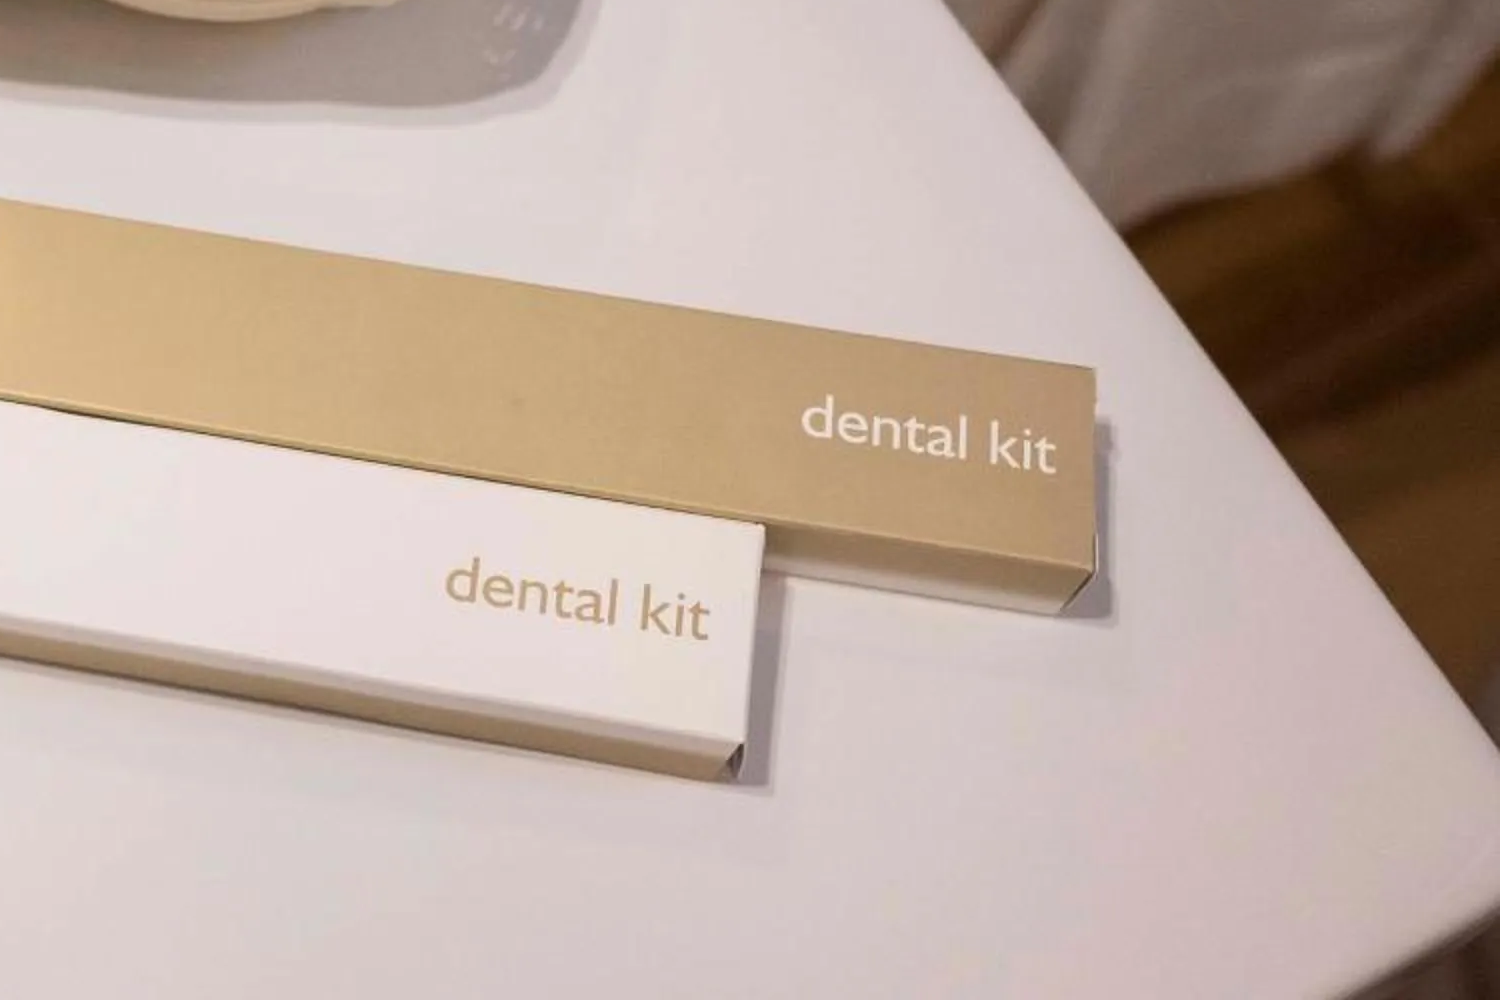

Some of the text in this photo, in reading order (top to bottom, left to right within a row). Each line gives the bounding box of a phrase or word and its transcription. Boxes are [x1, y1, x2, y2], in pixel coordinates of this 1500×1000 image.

[801, 394, 1058, 475] dental kit
[444, 556, 712, 642] dental kit
